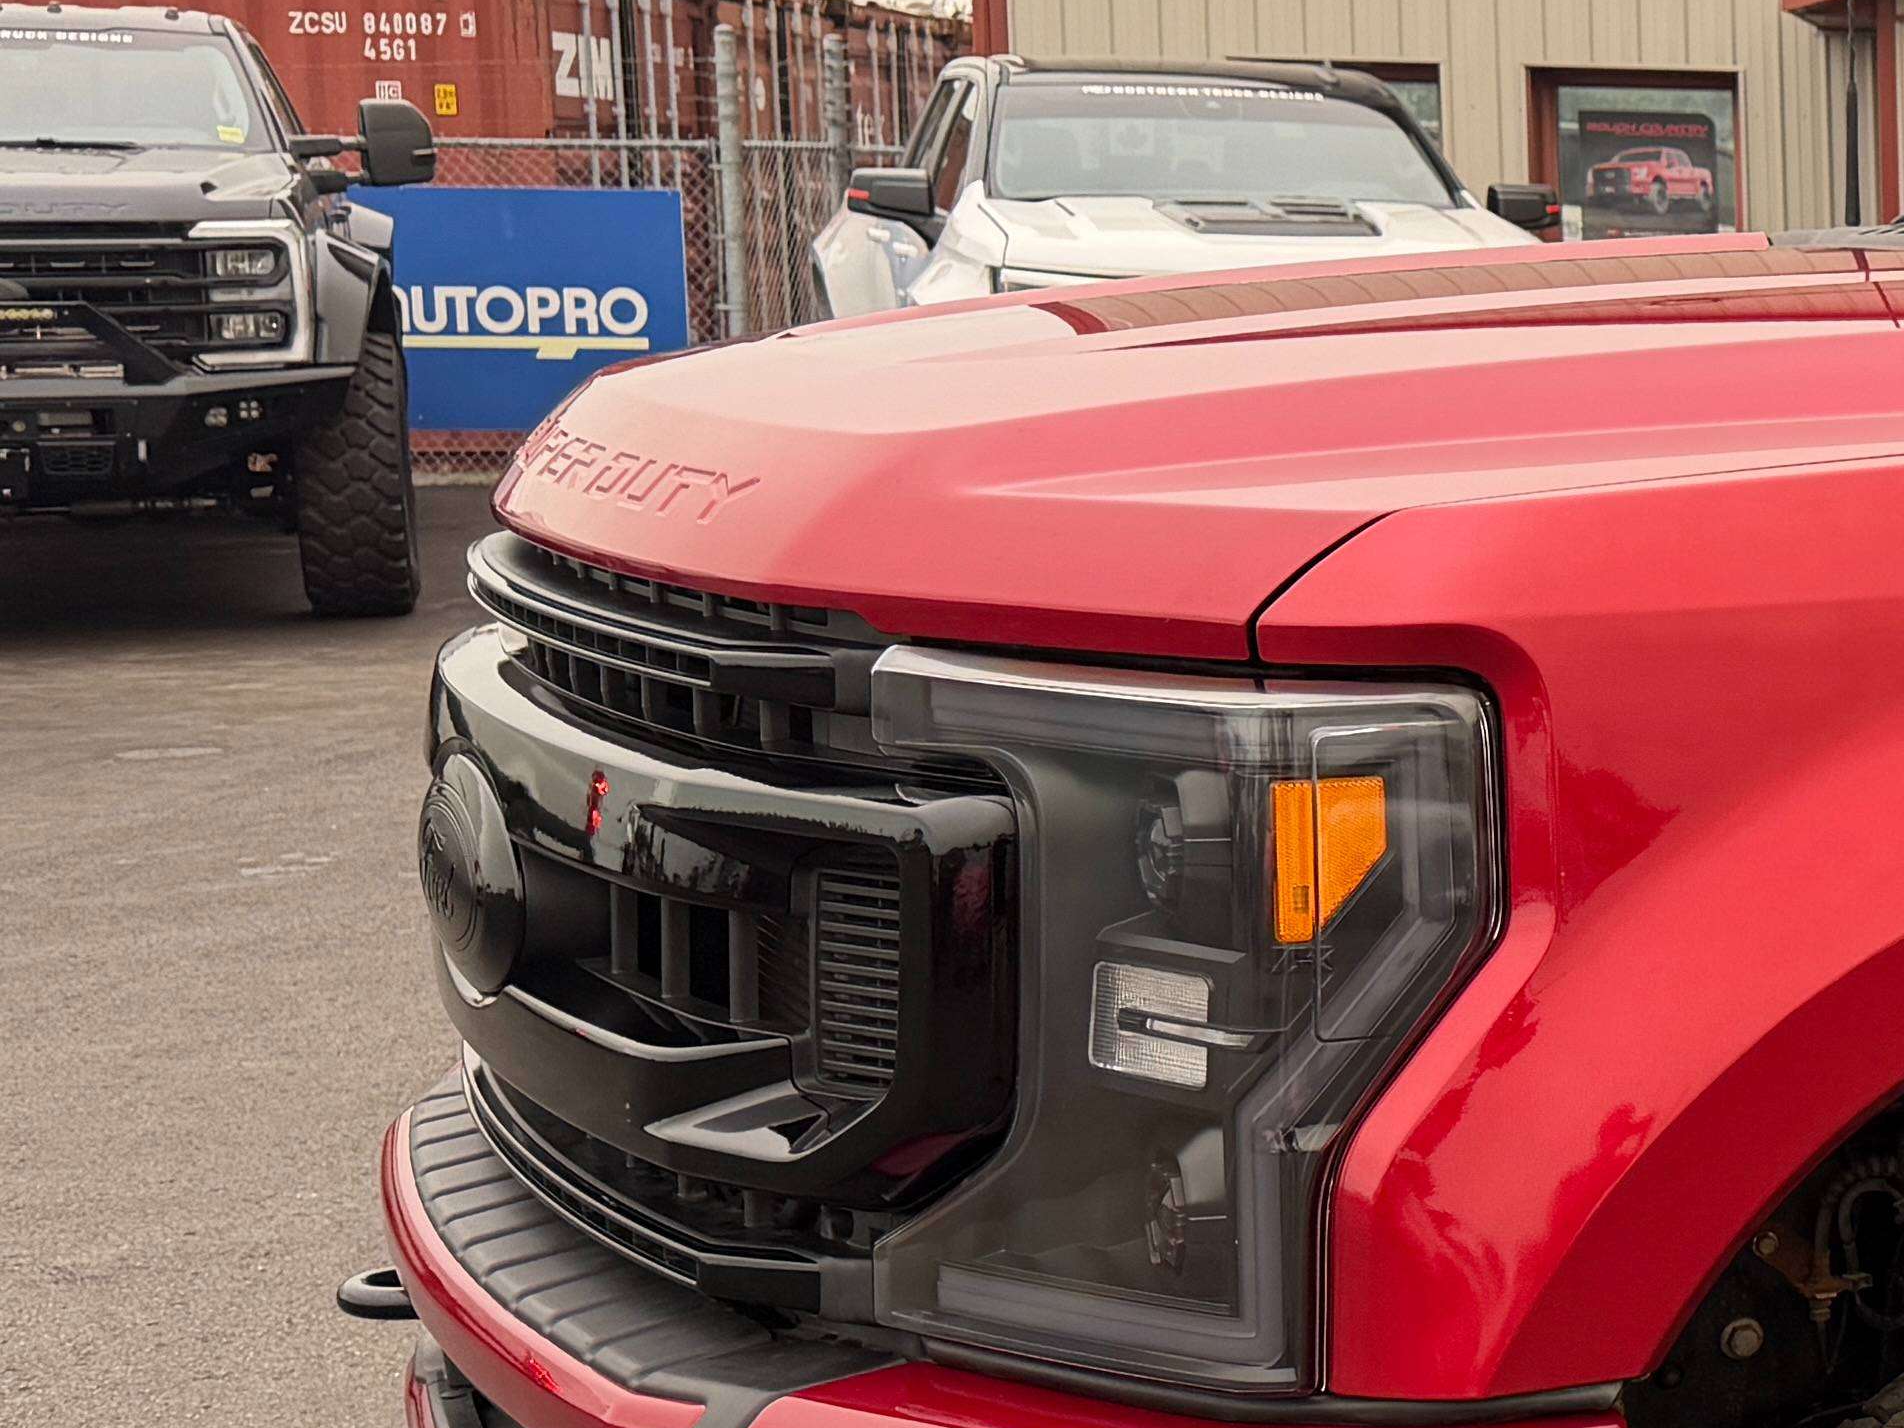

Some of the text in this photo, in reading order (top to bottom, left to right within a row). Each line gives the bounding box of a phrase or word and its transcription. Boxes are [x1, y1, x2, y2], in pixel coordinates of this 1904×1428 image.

[288, 11, 347, 34] ZCSU
[363, 12, 447, 36] 840087
[364, 38, 416, 61] 45G1
[583, 450, 760, 524] DUTY
